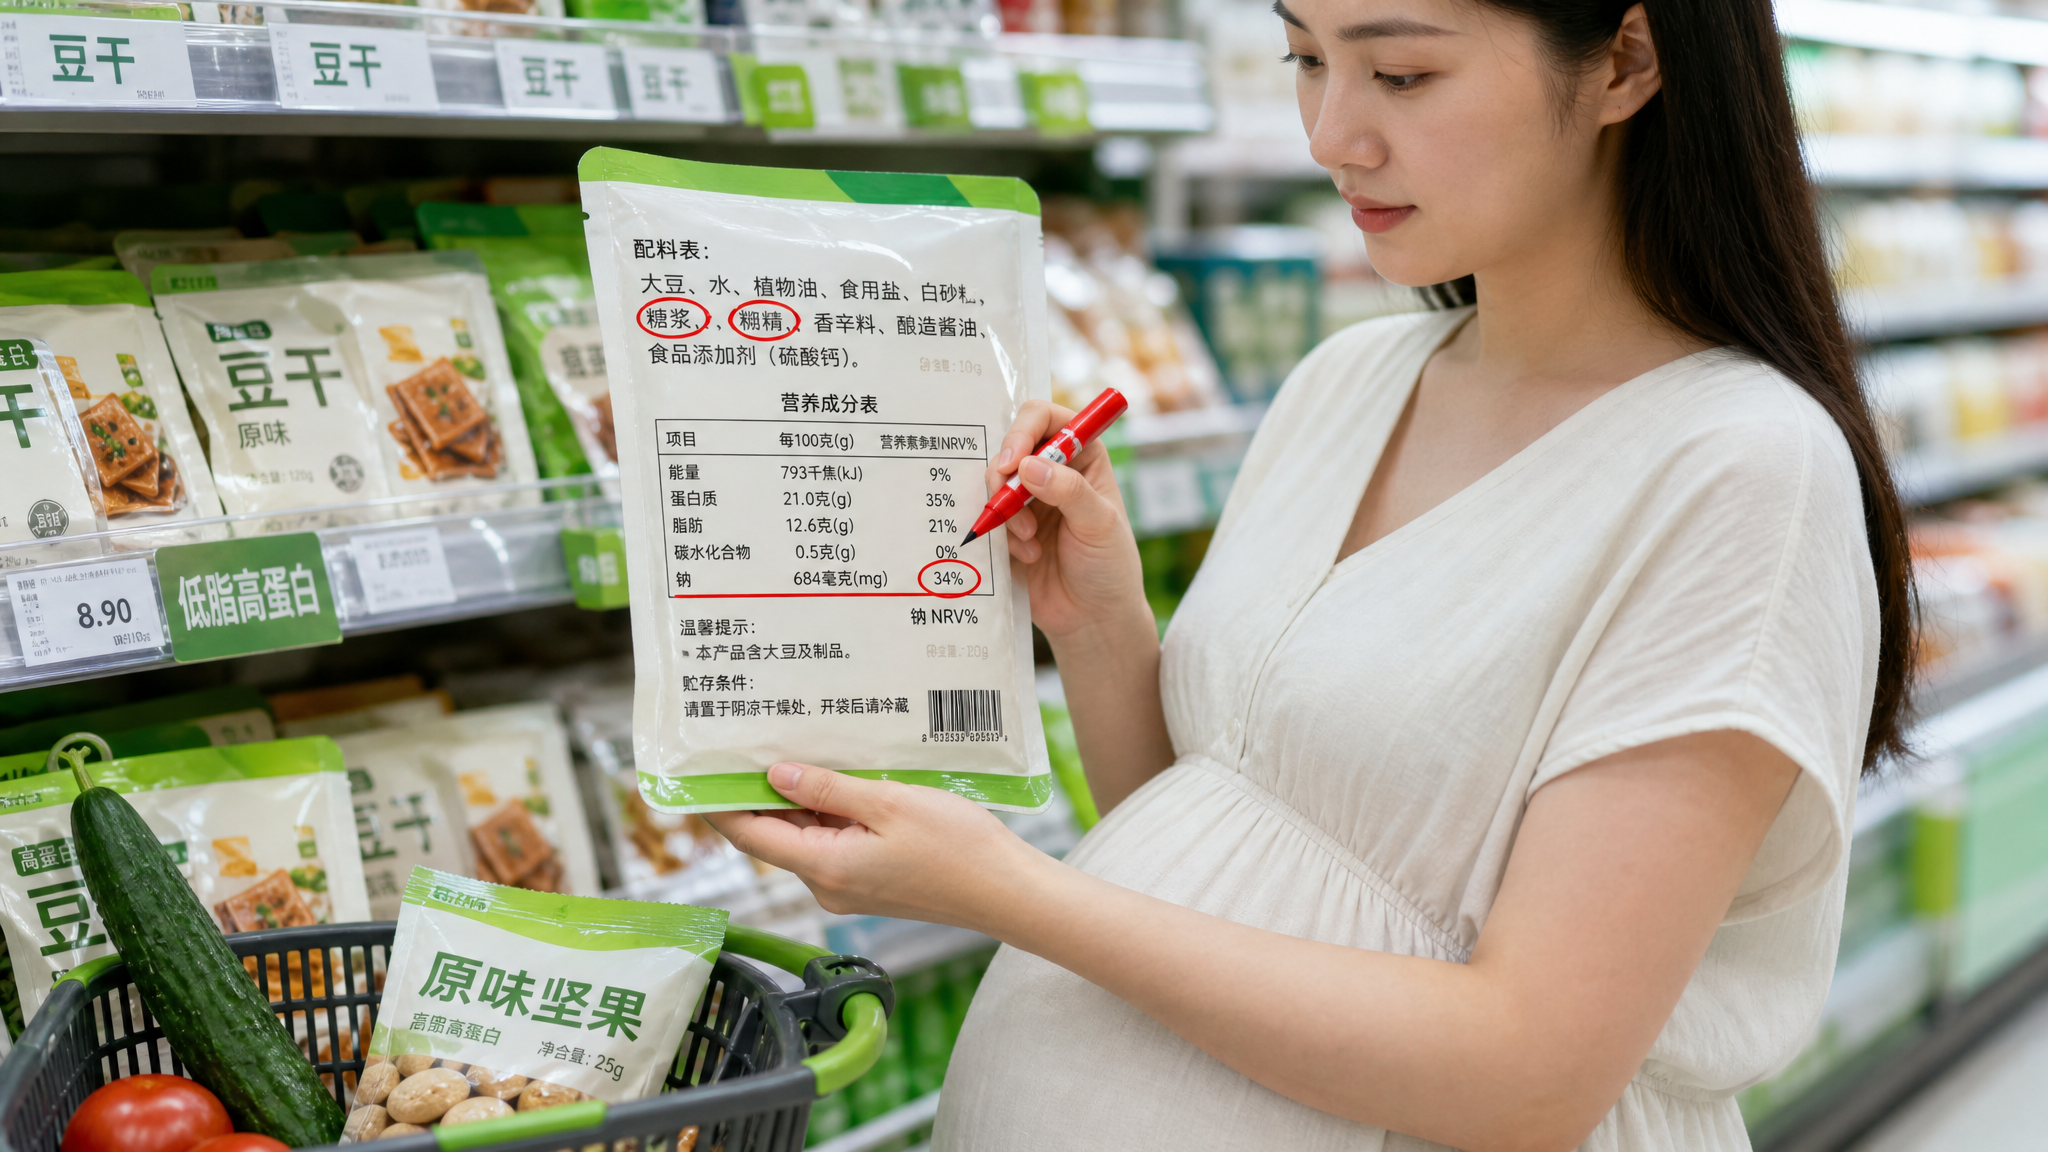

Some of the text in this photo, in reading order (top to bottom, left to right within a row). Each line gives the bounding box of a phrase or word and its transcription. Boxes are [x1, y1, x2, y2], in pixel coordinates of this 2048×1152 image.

[49, 34, 135, 84] 豆干
[310, 42, 382, 88] 豆干
[521, 57, 579, 98] 豆干
[639, 64, 691, 102] 豆干
[633, 238, 709, 260] 配料表：
[648, 342, 858, 369] 食品添加剂（硫酸钙）。
[219, 347, 342, 412] 豆干
[781, 392, 878, 414] 营养成分表
[238, 419, 292, 450] 原味
[666, 431, 696, 447] 项目
[779, 432, 854, 450] 每100克(g)
[668, 464, 700, 481] 能量
[781, 465, 863, 482] 793千焦(kJ)
[929, 467, 951, 482] 9%
[670, 490, 718, 507] 蛋白质
[783, 491, 852, 509] 21.0克(g)
[926, 493, 955, 507] 35%
[672, 517, 703, 534] 脂肪
[786, 517, 854, 536] 12.6克(g)
[929, 519, 957, 533] 21%
[674, 544, 751, 561] 碳水化合物
[796, 544, 856, 562] 0.5克(g)
[935, 545, 958, 559] 0%
[676, 571, 692, 588] 钠
[794, 570, 888, 588] 684毫克(mg)
[934, 571, 964, 585] 34%
[178, 562, 320, 631] 低脂高蛋白
[77, 598, 132, 629] 8.90
[911, 608, 979, 625] 钠 NRV%
[680, 619, 756, 636] 温馨提示：
[683, 674, 754, 692] 贮存条件：
[27, 879, 107, 956] 豆
[418, 951, 647, 1042] 原味坚果
